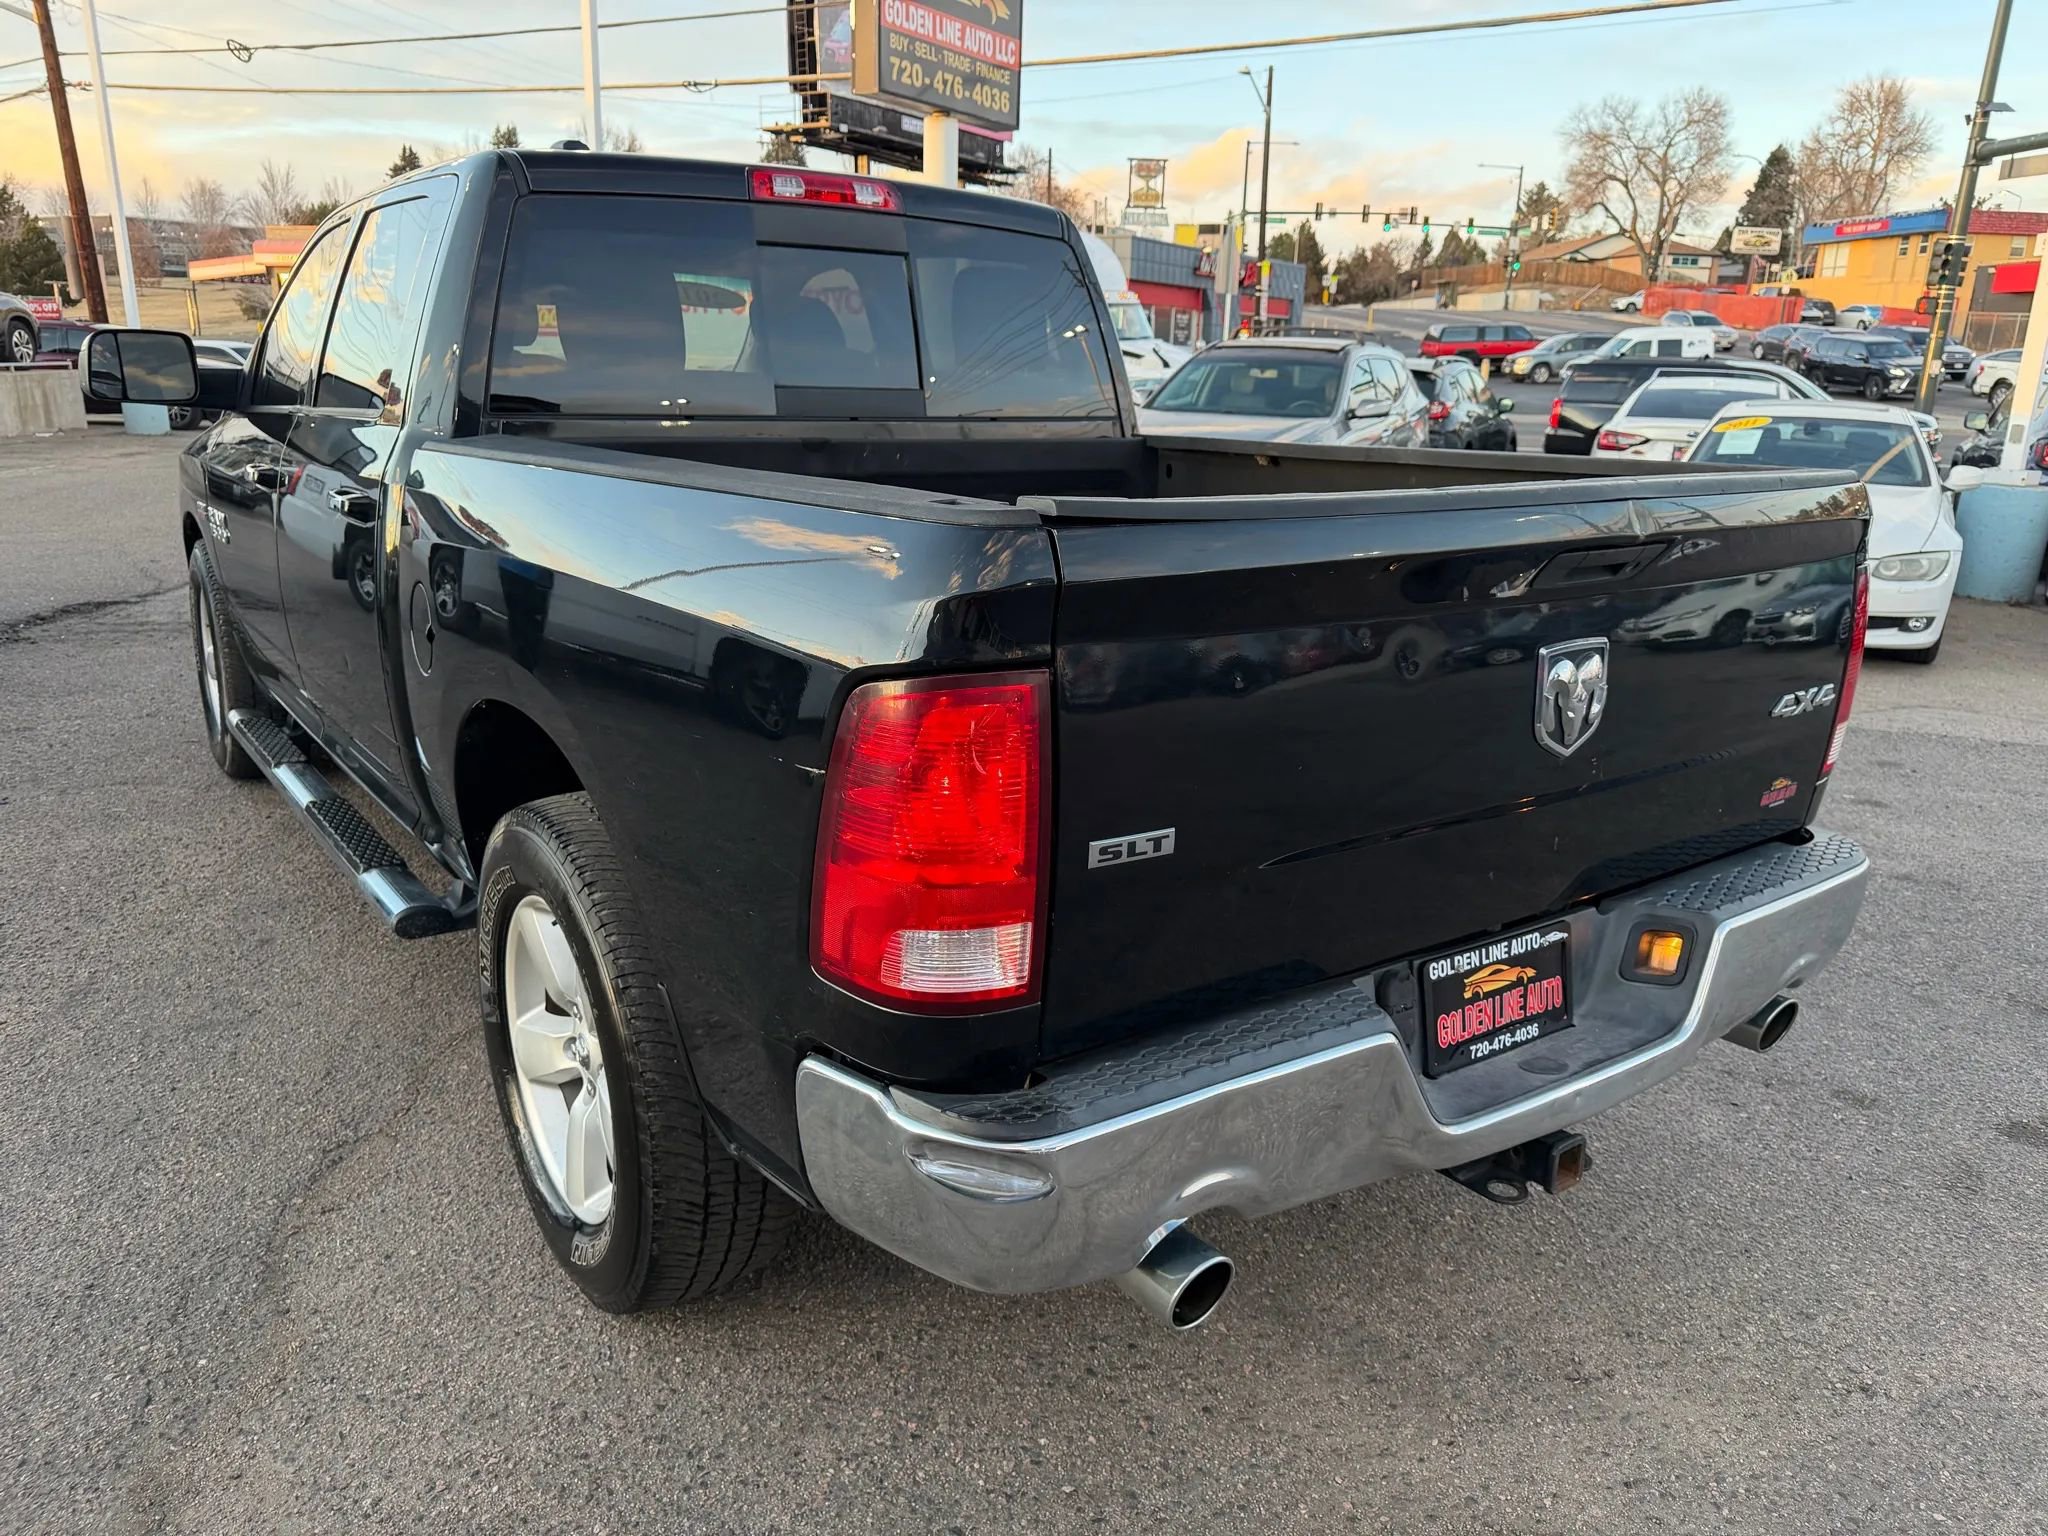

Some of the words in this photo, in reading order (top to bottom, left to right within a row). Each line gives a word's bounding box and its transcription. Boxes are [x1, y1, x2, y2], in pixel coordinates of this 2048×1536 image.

[885, 0, 933, 38] GOLDEN
[936, 17, 962, 47] LINE
[964, 26, 993, 59] AUTO
[995, 36, 1016, 65] LLC
[889, 32, 909, 53] BUY
[914, 41, 938, 62] SELL
[943, 50, 971, 73] TRADE
[975, 61, 1011, 86] FINANCE
[42, 303, 59, 312] OFF
[1096, 833, 1171, 864] SLT
[479, 865, 517, 987] MICHELIN
[1429, 950, 1480, 980] GOLDEN
[1482, 941, 1509, 966] LINE
[1511, 932, 1540, 957] AUTO
[1437, 998, 1493, 1048] GOLDEN
[1495, 986, 1524, 1028] LINE
[1526, 975, 1563, 1016] AUTO
[1470, 1023, 1539, 1059] 720-476-4036
